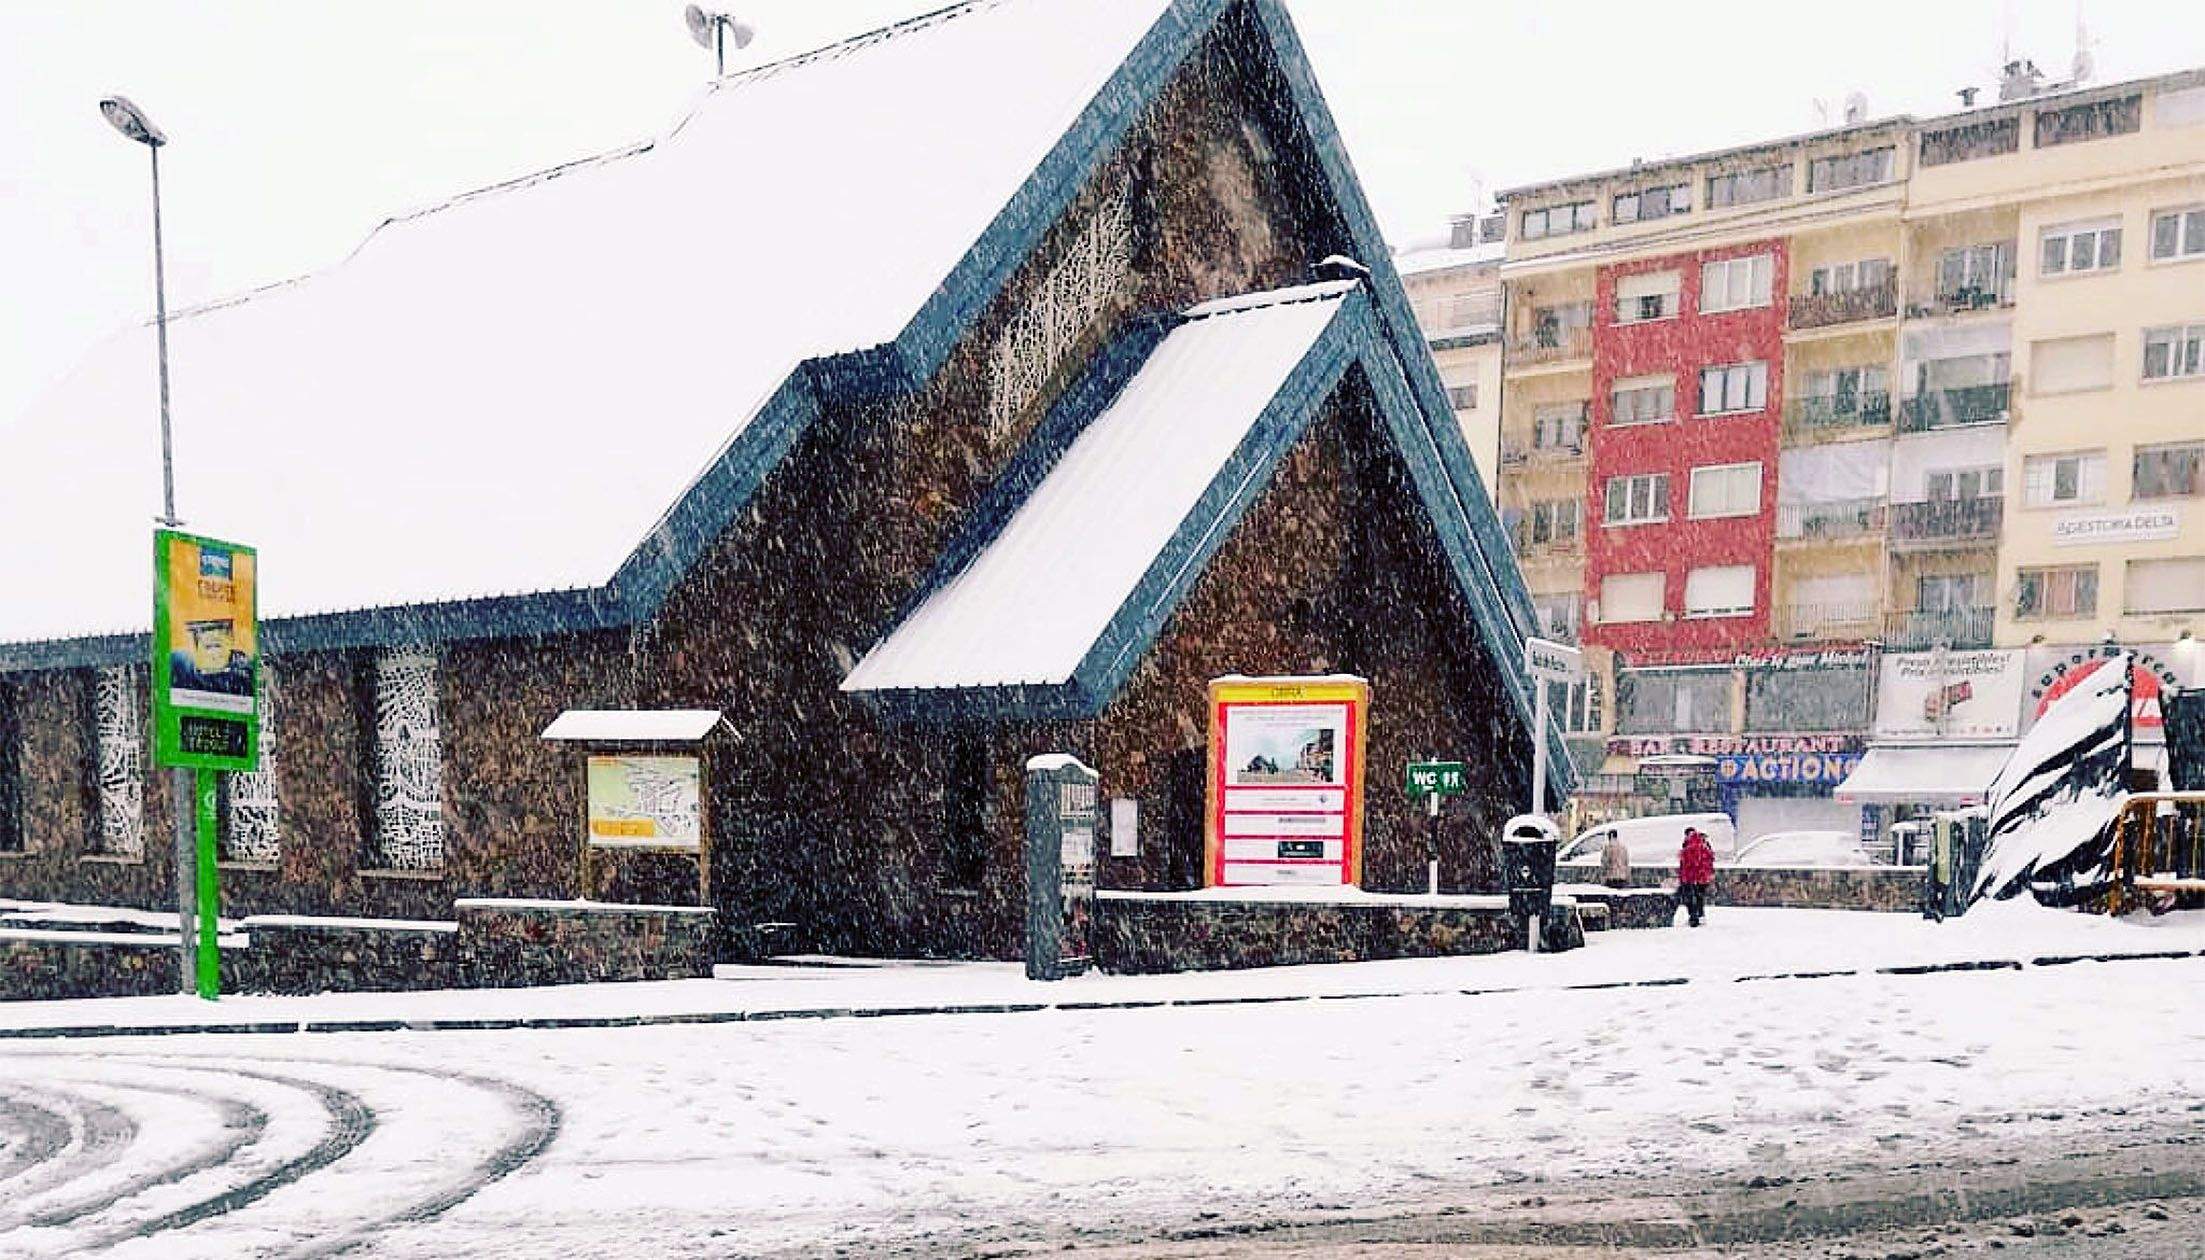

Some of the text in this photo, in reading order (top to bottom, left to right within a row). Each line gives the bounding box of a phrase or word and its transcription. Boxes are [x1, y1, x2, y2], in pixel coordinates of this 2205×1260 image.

[1629, 736, 1844, 755] BAR RESTAURANT
[1412, 771, 1437, 785] WC
